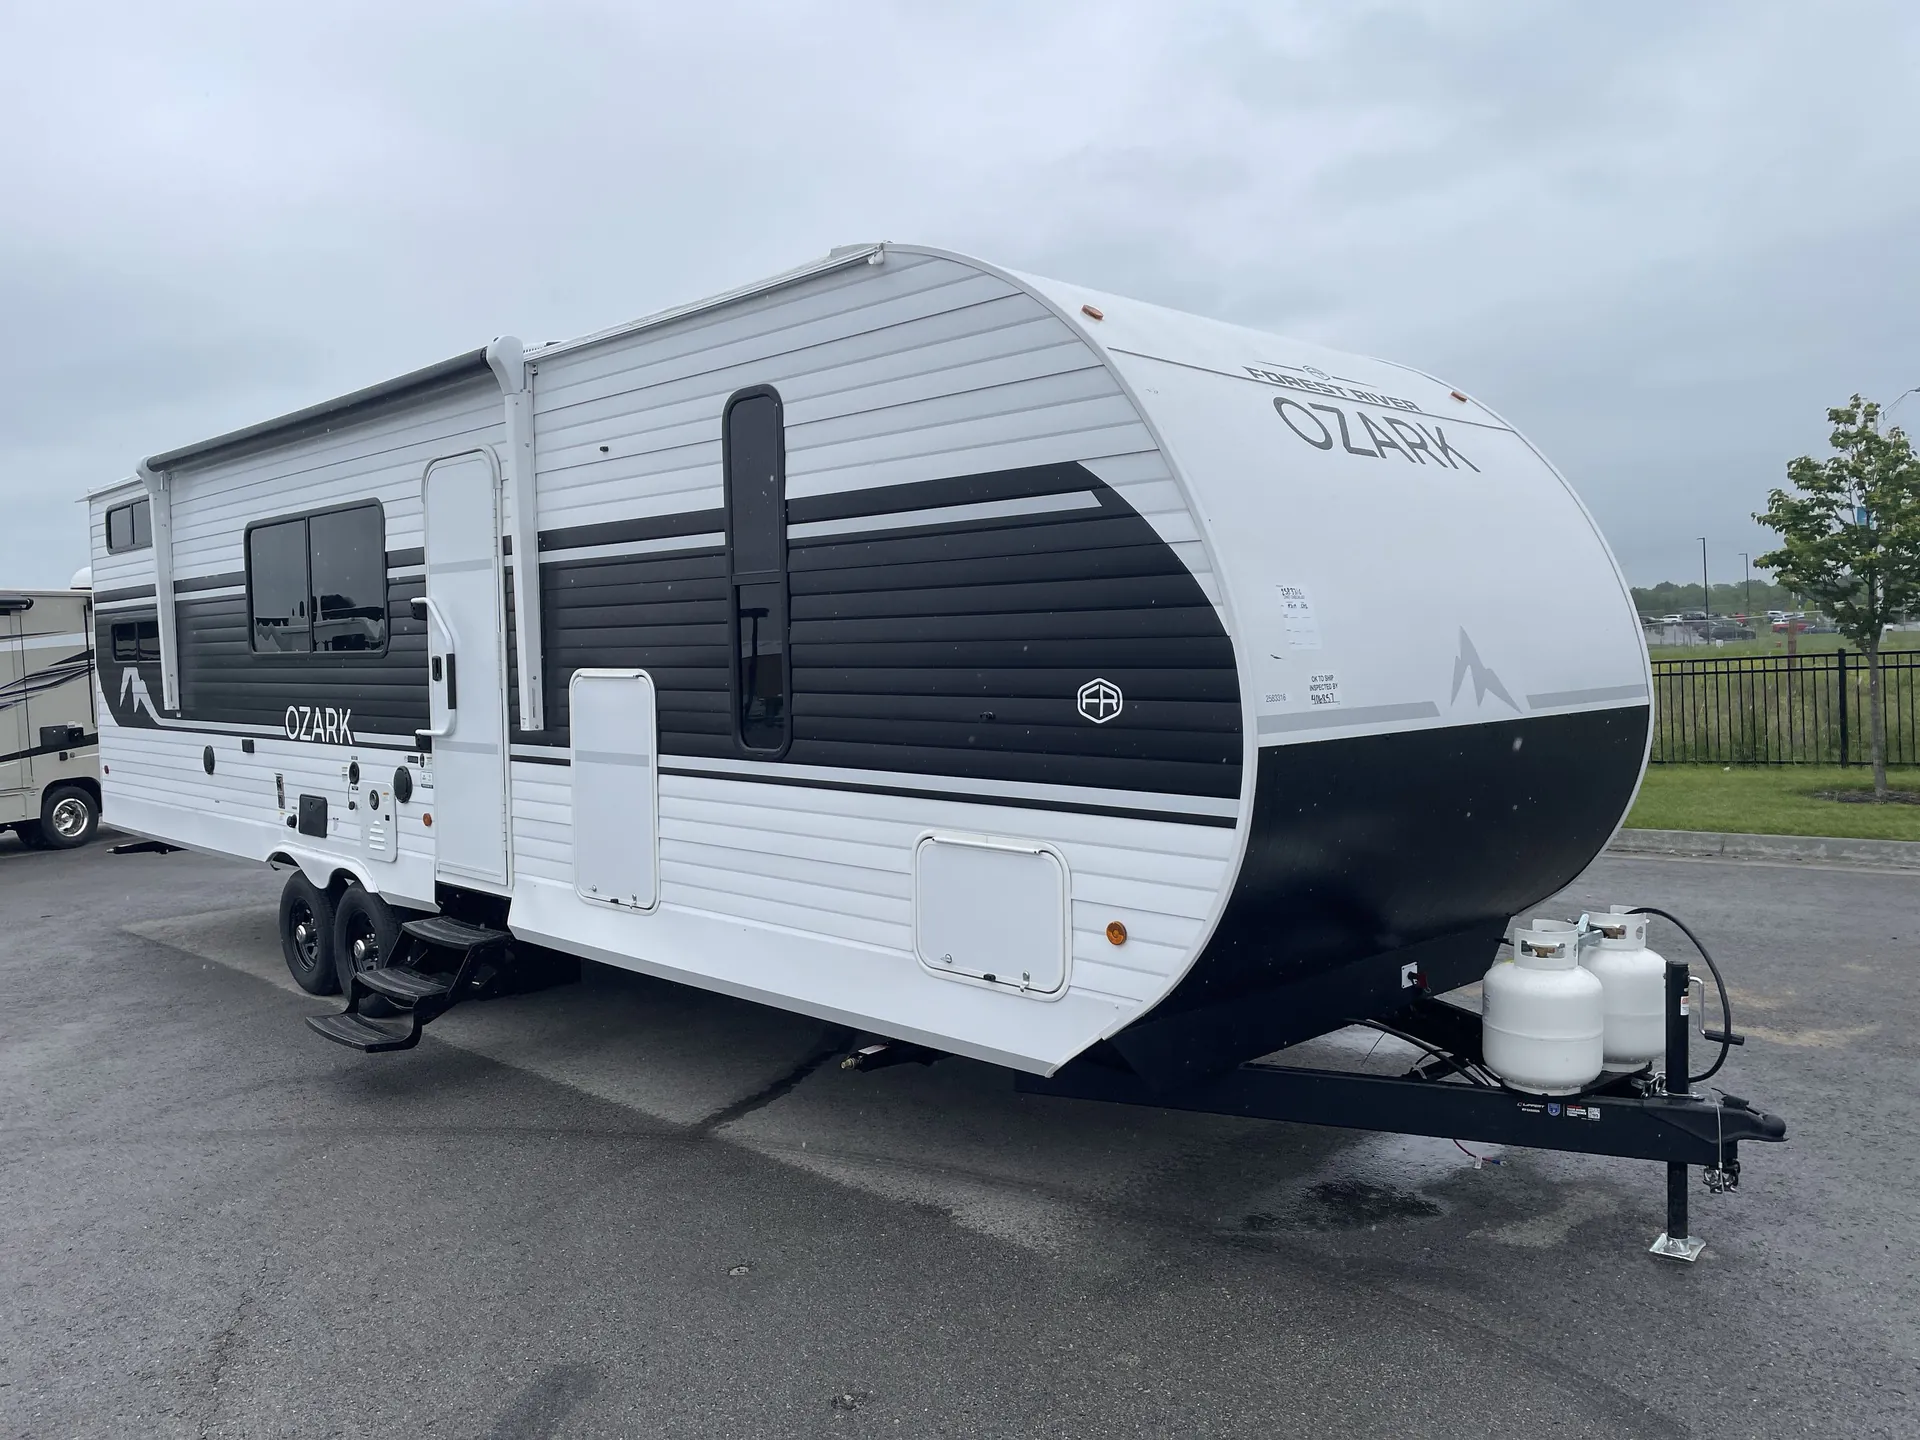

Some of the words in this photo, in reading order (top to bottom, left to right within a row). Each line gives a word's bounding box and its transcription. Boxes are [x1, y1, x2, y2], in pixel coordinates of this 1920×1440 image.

[1242, 366, 1347, 397] FOREST
[1347, 388, 1422, 412] RIVER
[1273, 396, 1481, 473] OZARK
[1309, 683, 1332, 691] INSPECTED
[1332, 682, 1338, 690] BY
[1311, 675, 1318, 683] OK
[285, 705, 353, 745] OZARK
